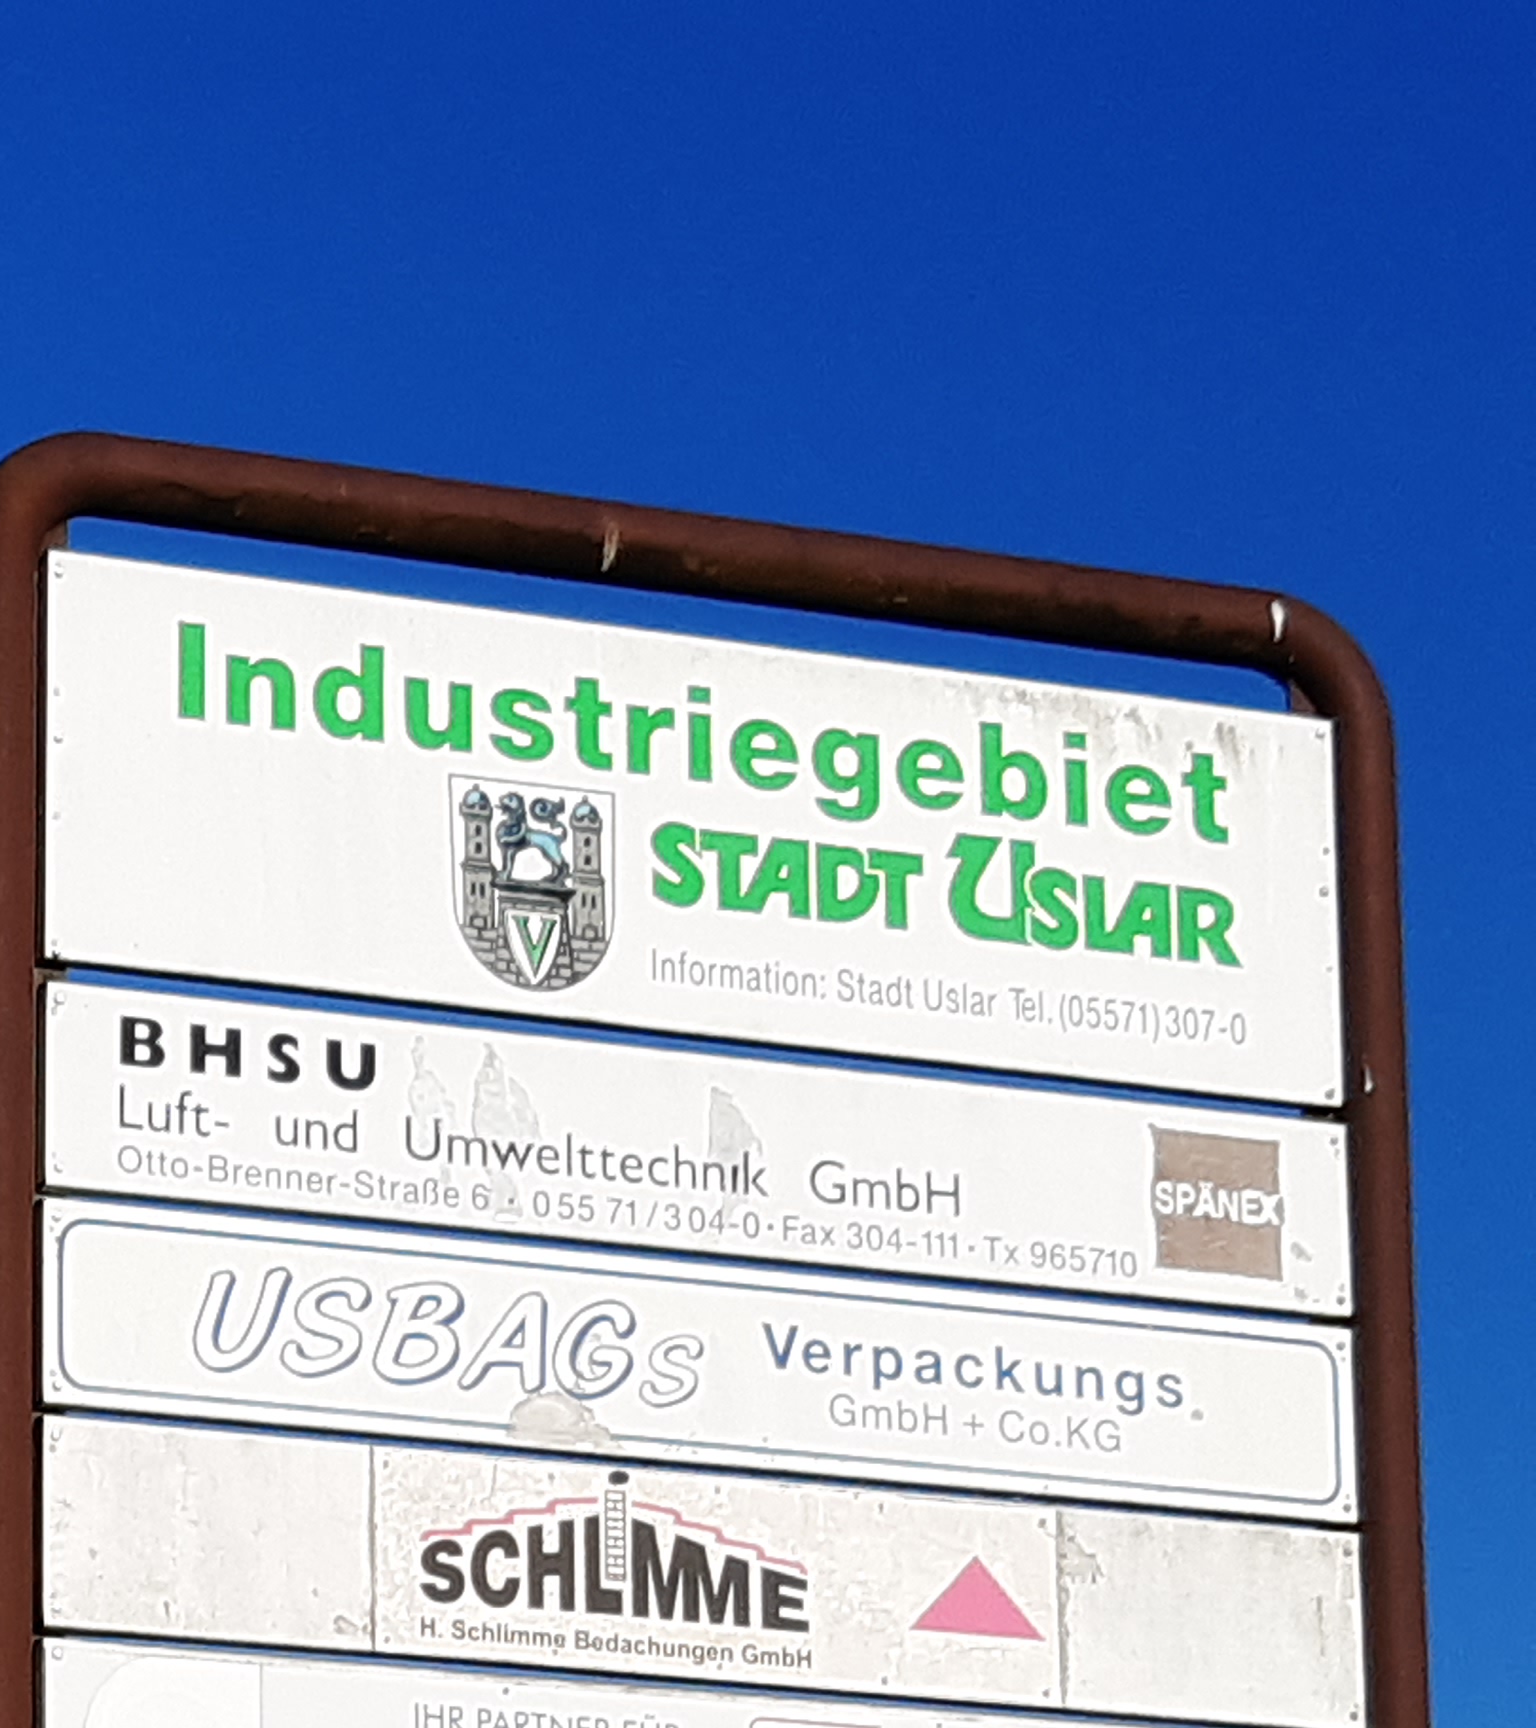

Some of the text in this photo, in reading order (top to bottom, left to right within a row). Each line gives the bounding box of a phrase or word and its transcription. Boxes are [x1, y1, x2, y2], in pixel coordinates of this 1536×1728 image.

[178, 620, 1230, 844] Industriegebiet
[651, 822, 924, 929] STADT
[650, 949, 827, 1000] Information:
[837, 970, 915, 1011] Stadt
[924, 978, 995, 1018] Uslar
[119, 1084, 961, 1216] Luft- und Umwelttechnik GmbH
[117, 1145, 459, 1210] Otto-Brenner-Straße
[472, 1183, 490, 1211] 6
[1031, 1242, 1137, 1278] 965710
[1154, 1178, 1283, 1226] SPÄNEX
[829, 1393, 948, 1436] GmbH
[420, 1617, 812, 1669] H. Schlimme Bedachungen GmbH
